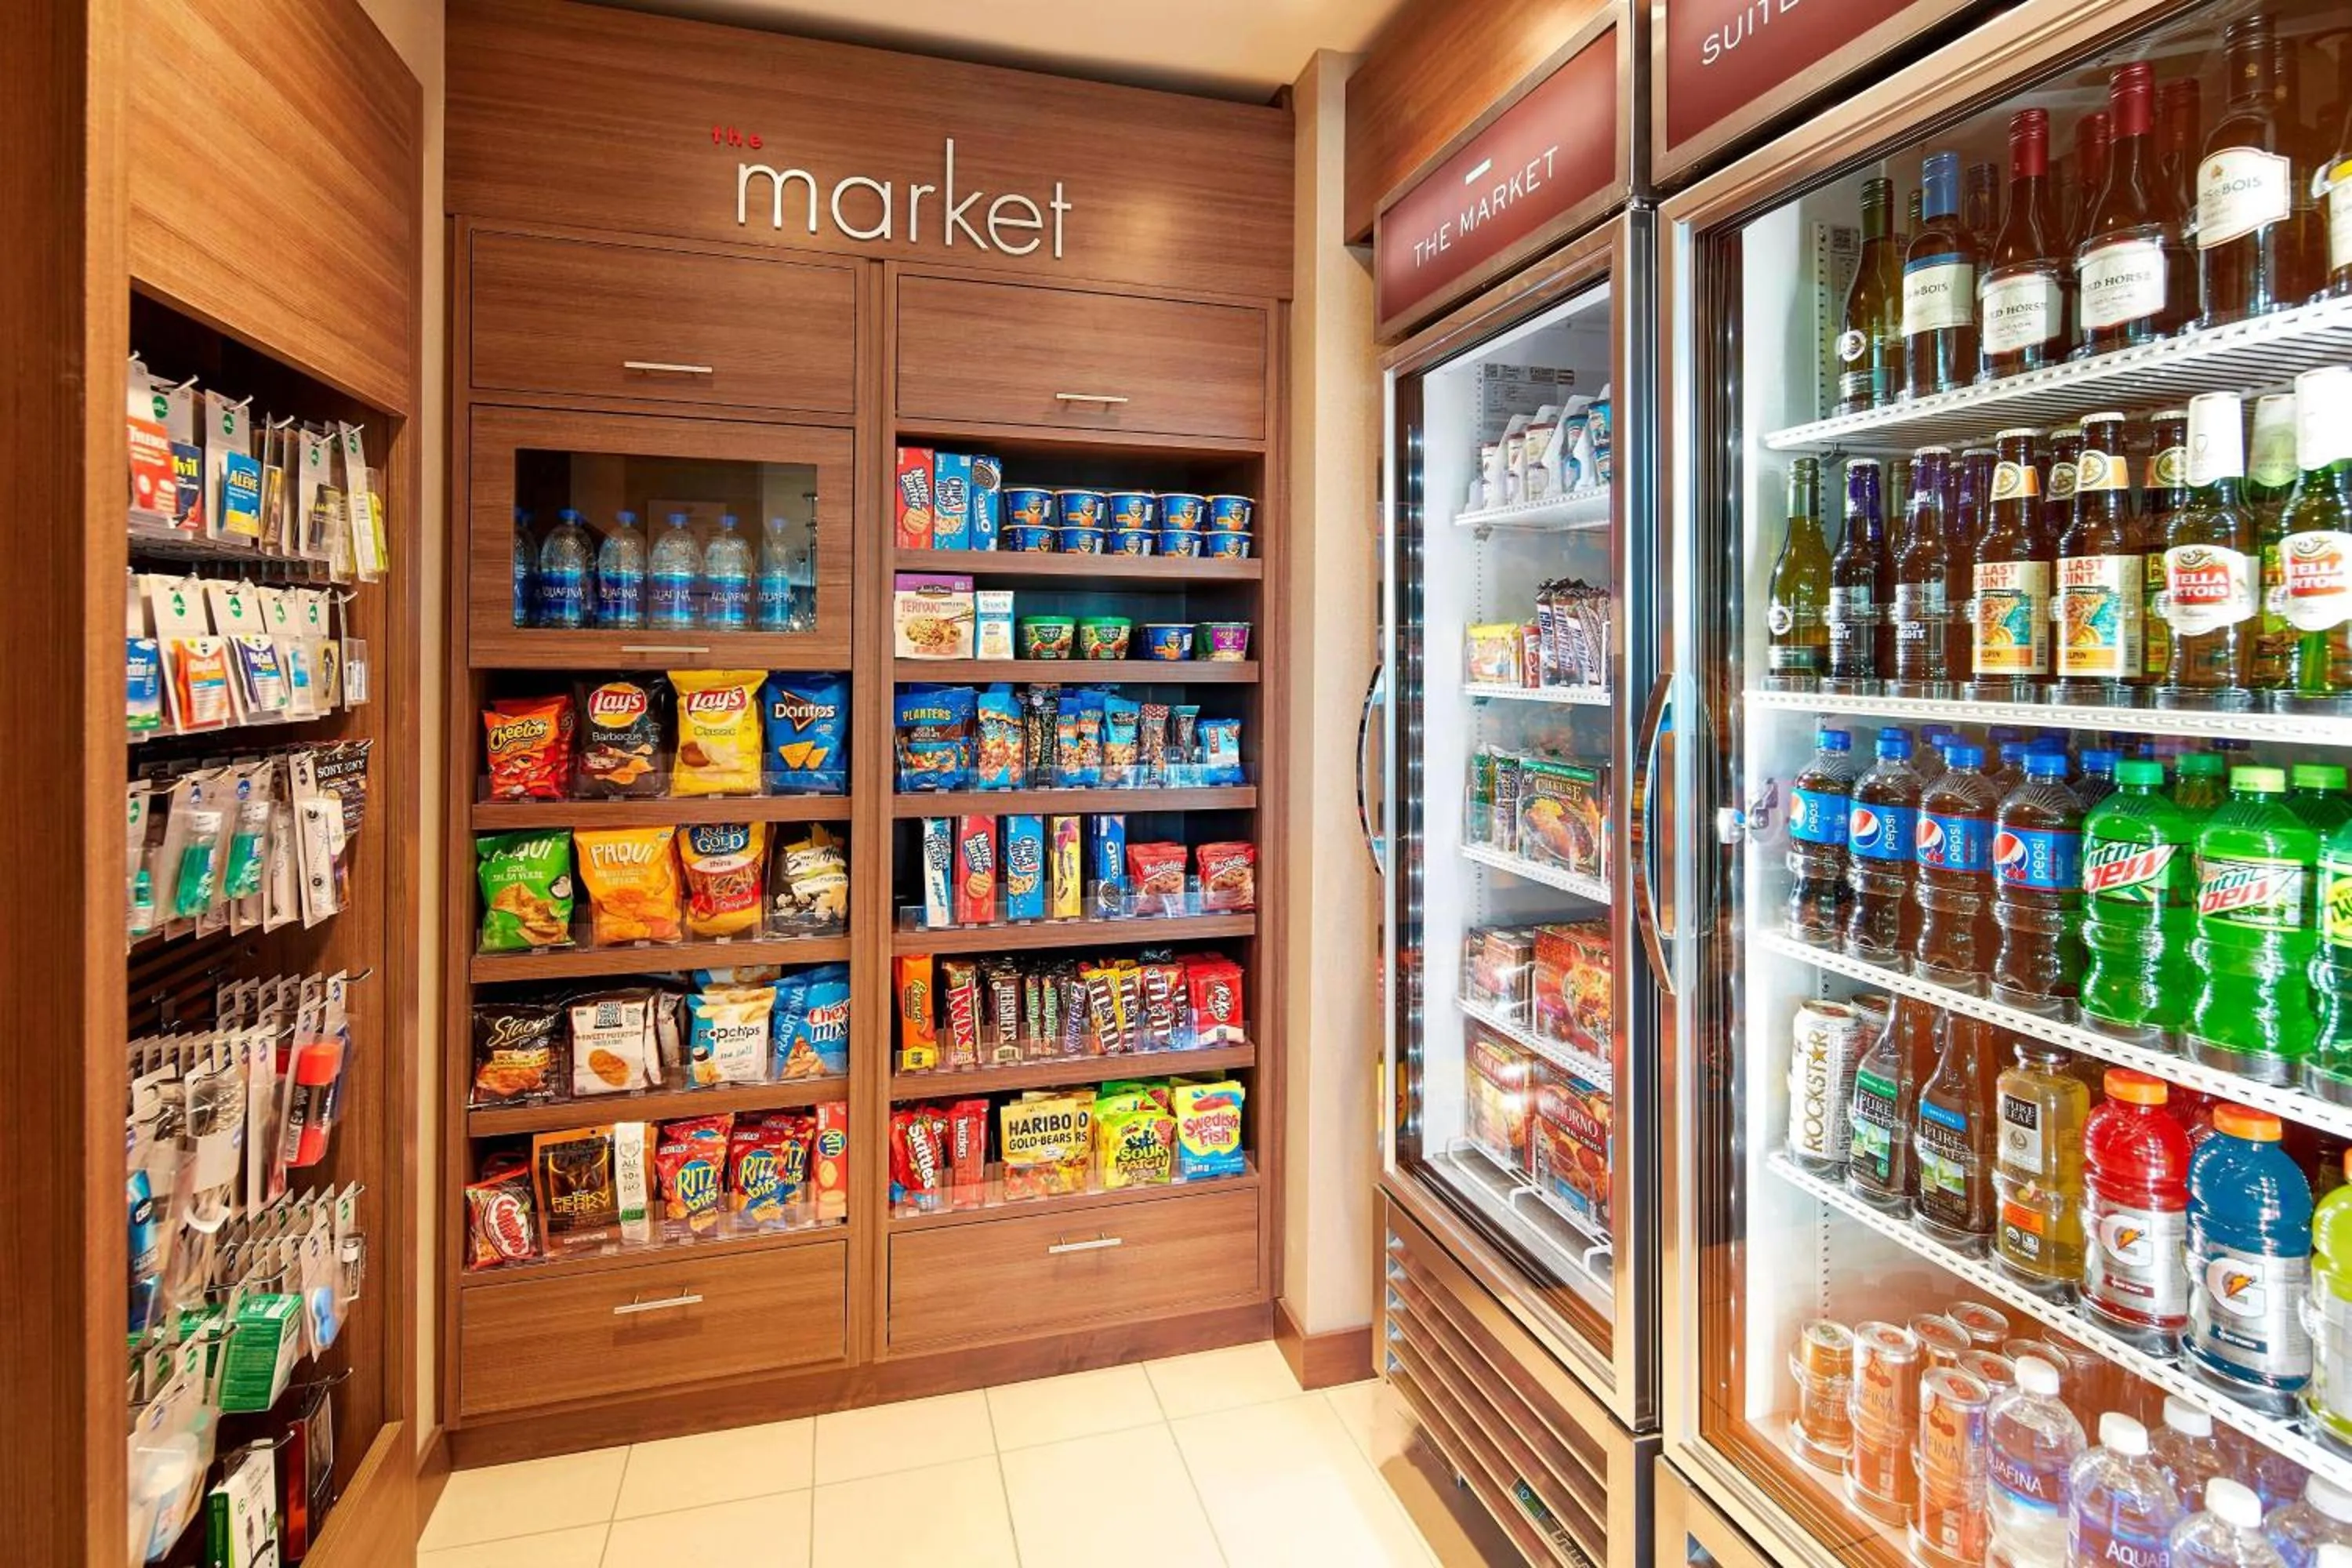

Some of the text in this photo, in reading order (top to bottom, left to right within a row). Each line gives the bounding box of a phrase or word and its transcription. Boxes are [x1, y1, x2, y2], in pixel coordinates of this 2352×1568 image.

[711, 125, 764, 150] the
[1459, 146, 1559, 238] MARKET
[2222, 176, 2263, 194] BOIS
[737, 137, 1072, 259] market
[1414, 222, 1452, 269] THE
[1921, 282, 1948, 296] BOIS
[2104, 272, 2151, 286] HORSE
[901, 474, 921, 510] Butter
[911, 468, 930, 504] Nutter
[978, 493, 991, 533] OREO
[1979, 564, 2017, 576] LAST
[2063, 558, 2106, 572] LAST
[2175, 572, 2227, 584] ELLA
[541, 587, 585, 600] QUAFINA
[601, 586, 638, 601] QUAFINA
[653, 587, 691, 601] QUAFINA
[2174, 585, 2229, 597] TOIS
[902, 601, 941, 613] TERIYAKI
[593, 690, 643, 714] Lay's
[689, 688, 743, 712] Lay's
[774, 703, 836, 718] Doritos
[902, 708, 952, 721] PLANTERS
[489, 720, 547, 752] Cheetos
[694, 725, 737, 737] Classic
[318, 763, 343, 779] SONY
[1808, 798, 1820, 833] pepsi
[697, 834, 744, 853] GOLD
[1885, 815, 1898, 851] pepsi
[1947, 824, 1962, 863] pepsi
[964, 839, 985, 874] Butter
[975, 830, 993, 869] Nutter
[1106, 840, 1119, 879] OREO
[2033, 838, 2045, 880] pepsi
[808, 1002, 850, 1025] Chex
[949, 978, 975, 1048] TWIX
[1000, 984, 1017, 1042] HERSHEY'S
[1859, 1094, 1891, 1116] PURE
[2005, 1099, 2036, 1116] PURE
[1009, 1113, 1072, 1137] HARIBO
[1183, 1111, 1239, 1137] Swedish
[1924, 1123, 1966, 1146] PURE
[1009, 1133, 1072, 1151] GOLD-BEARS
[1197, 1127, 1232, 1146] Fish
[908, 1123, 935, 1189] Skittles
[1120, 1145, 1166, 1161] SOUR
[739, 1156, 776, 1187] RITZ
[1116, 1156, 1168, 1174] PATCH
[675, 1166, 717, 1200] RITZ
[746, 1177, 778, 1200] bits
[686, 1188, 717, 1210] bits
[1986, 1450, 2044, 1498] QUAFINA
[2106, 1540, 2170, 1568] AQUAF
